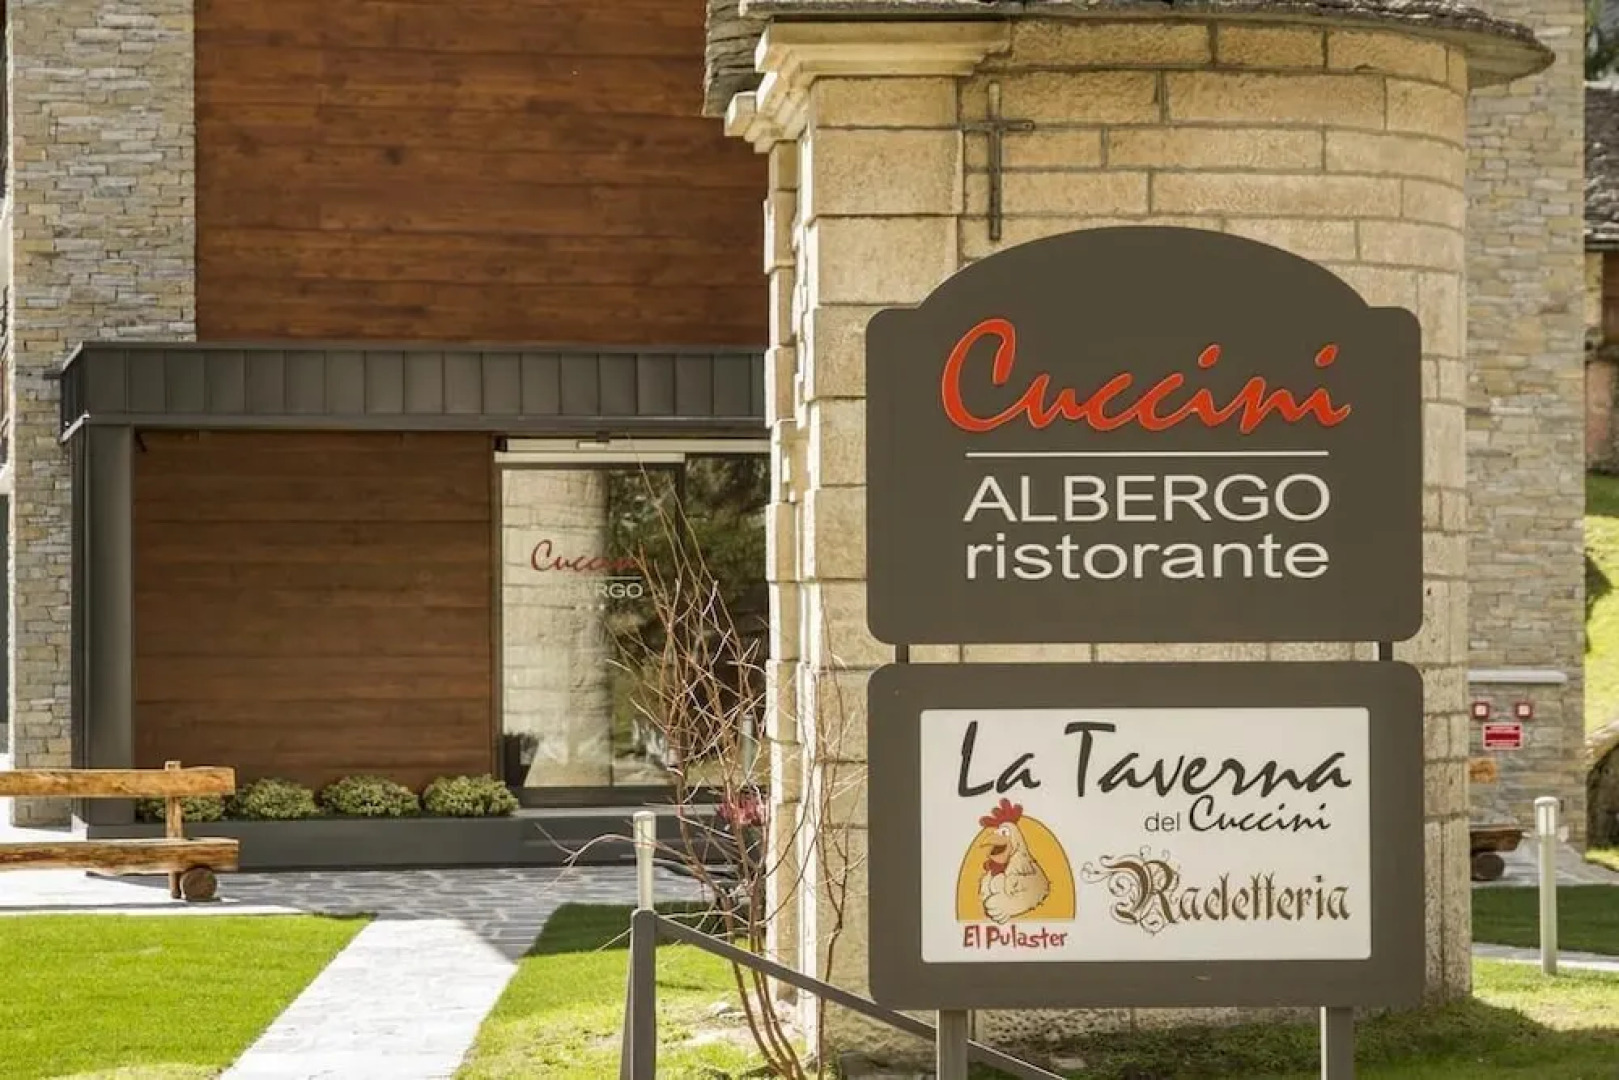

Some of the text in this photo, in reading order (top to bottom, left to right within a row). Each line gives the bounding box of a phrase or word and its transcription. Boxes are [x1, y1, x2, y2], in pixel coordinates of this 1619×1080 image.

[941, 318, 1351, 434] Cuccini
[963, 473, 1331, 522] ALBERGO
[965, 532, 1330, 579] ristorante
[957, 720, 1352, 797] La Taverna
[1144, 795, 1331, 832] del Cuccini
[963, 924, 1068, 949] El Pulaster
